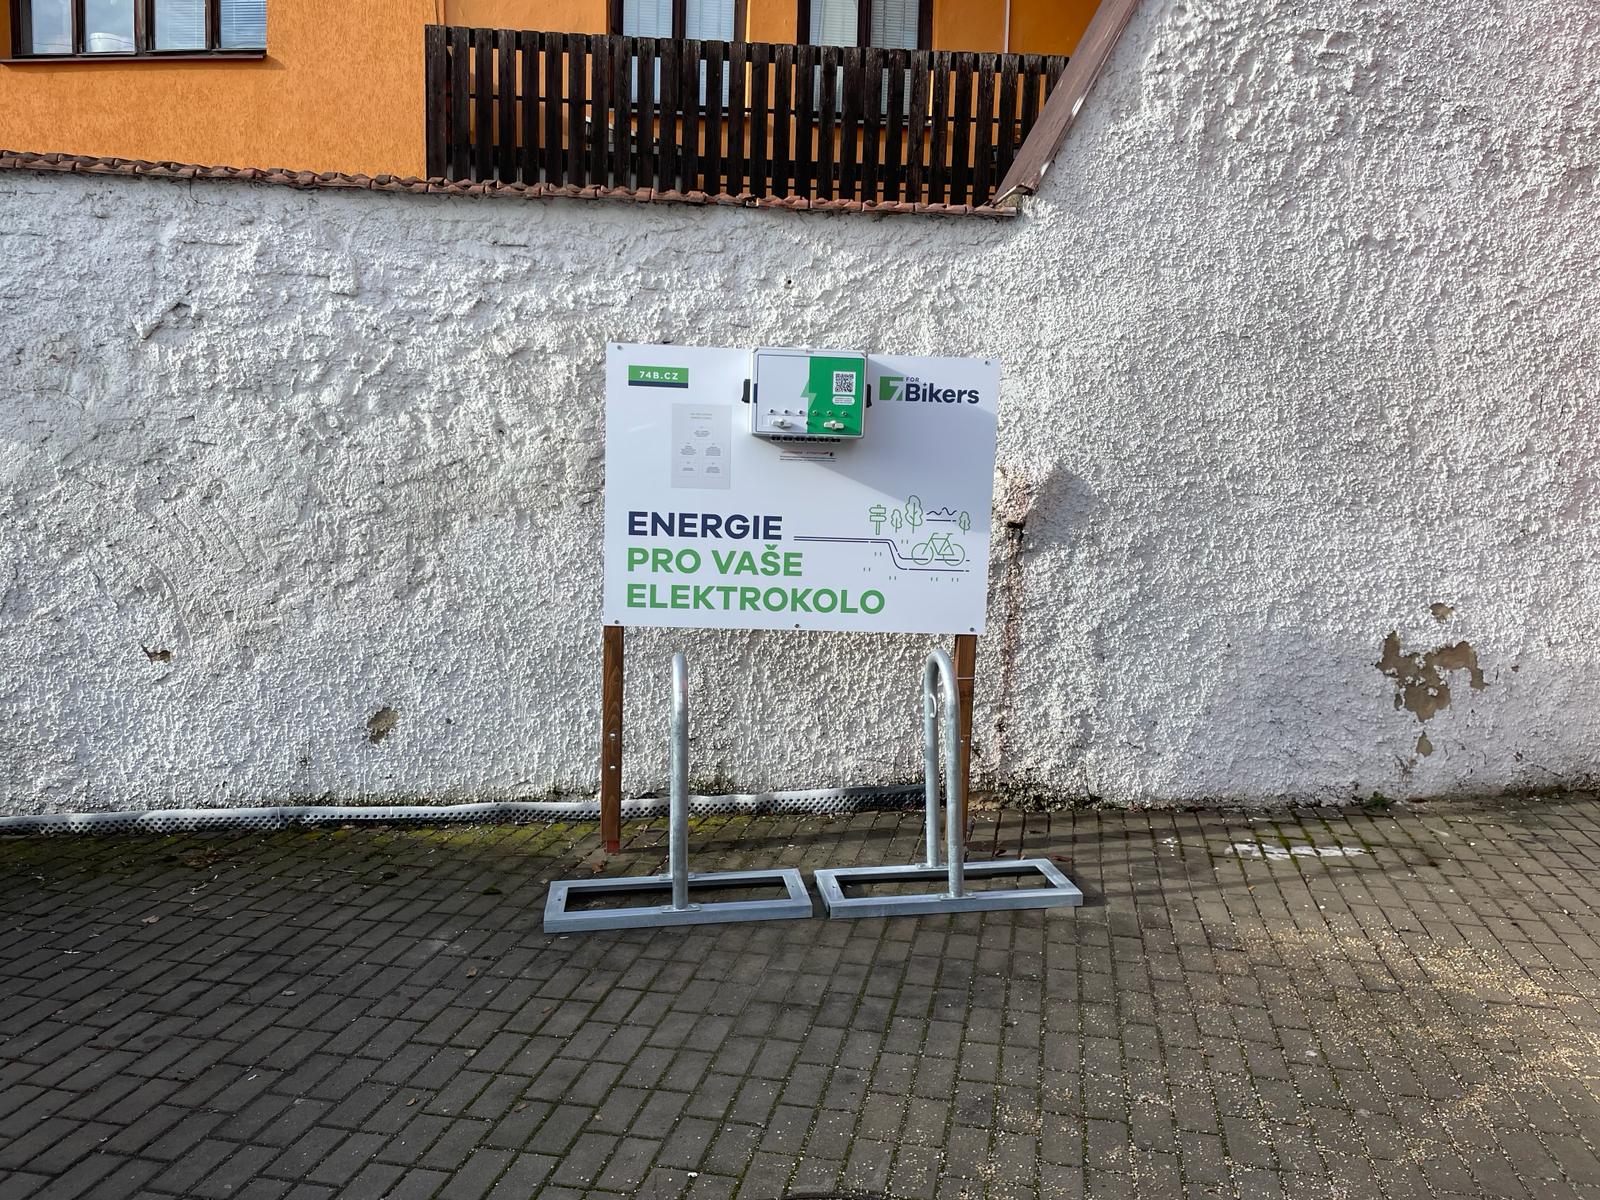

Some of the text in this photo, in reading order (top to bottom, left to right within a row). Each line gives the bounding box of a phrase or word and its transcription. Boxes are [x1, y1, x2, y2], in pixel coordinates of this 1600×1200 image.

[639, 371, 679, 380] 74B.CZ
[905, 382, 980, 404] Bikers
[627, 511, 783, 540] ENERGIE
[627, 544, 803, 577] PRO VAŠE
[626, 583, 886, 615] ELEKTROKOLO
